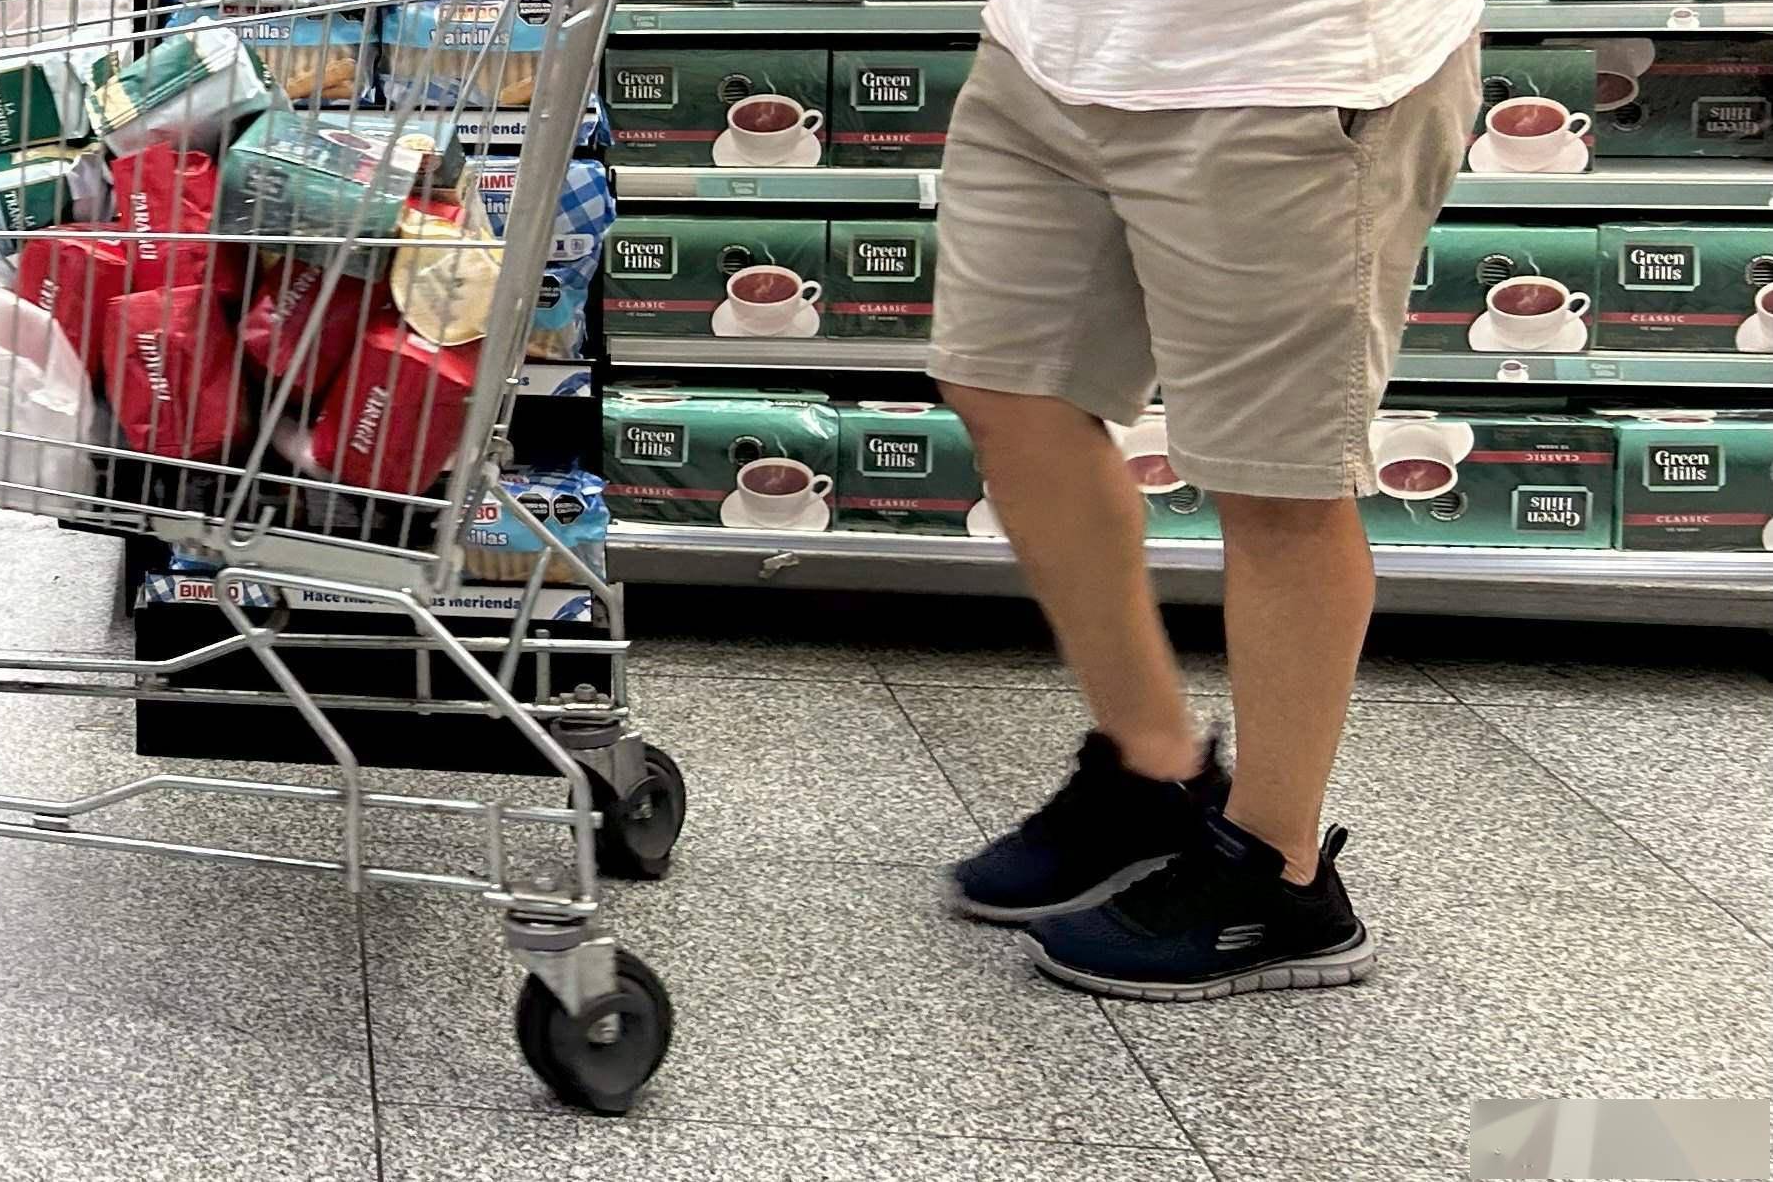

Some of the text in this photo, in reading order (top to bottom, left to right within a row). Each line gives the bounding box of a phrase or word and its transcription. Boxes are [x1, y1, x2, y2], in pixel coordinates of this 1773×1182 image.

[617, 71, 665, 88] Green
[862, 72, 911, 89] Green
[623, 84, 662, 99] Hills
[868, 87, 908, 102] Hills
[618, 130, 667, 139] CLASSIC
[862, 134, 912, 142] CLASSIC
[617, 240, 664, 256] Green
[858, 243, 907, 259] Green
[623, 254, 661, 270] Hills
[865, 257, 904, 272] Hills
[1630, 249, 1685, 267] Green
[1638, 265, 1683, 281] Hills
[618, 301, 666, 309] CLASSIC
[859, 304, 908, 312] CLASSIC
[1630, 315, 1685, 323] CLASSIC
[627, 427, 675, 443] Green
[633, 442, 672, 457] Hills
[868, 438, 919, 455] Green
[874, 453, 915, 468] Hills
[1526, 452, 1580, 462] CLASSIC
[1655, 451, 1710, 467] Green
[1663, 466, 1707, 482] Hills
[626, 488, 674, 497] CLASSIC
[869, 498, 919, 507] CLASSIC
[1530, 496, 1573, 512] Hills
[1527, 509, 1580, 527] Green
[1656, 515, 1711, 523] CLASSIC
[180, 583, 239, 600] BIMO
